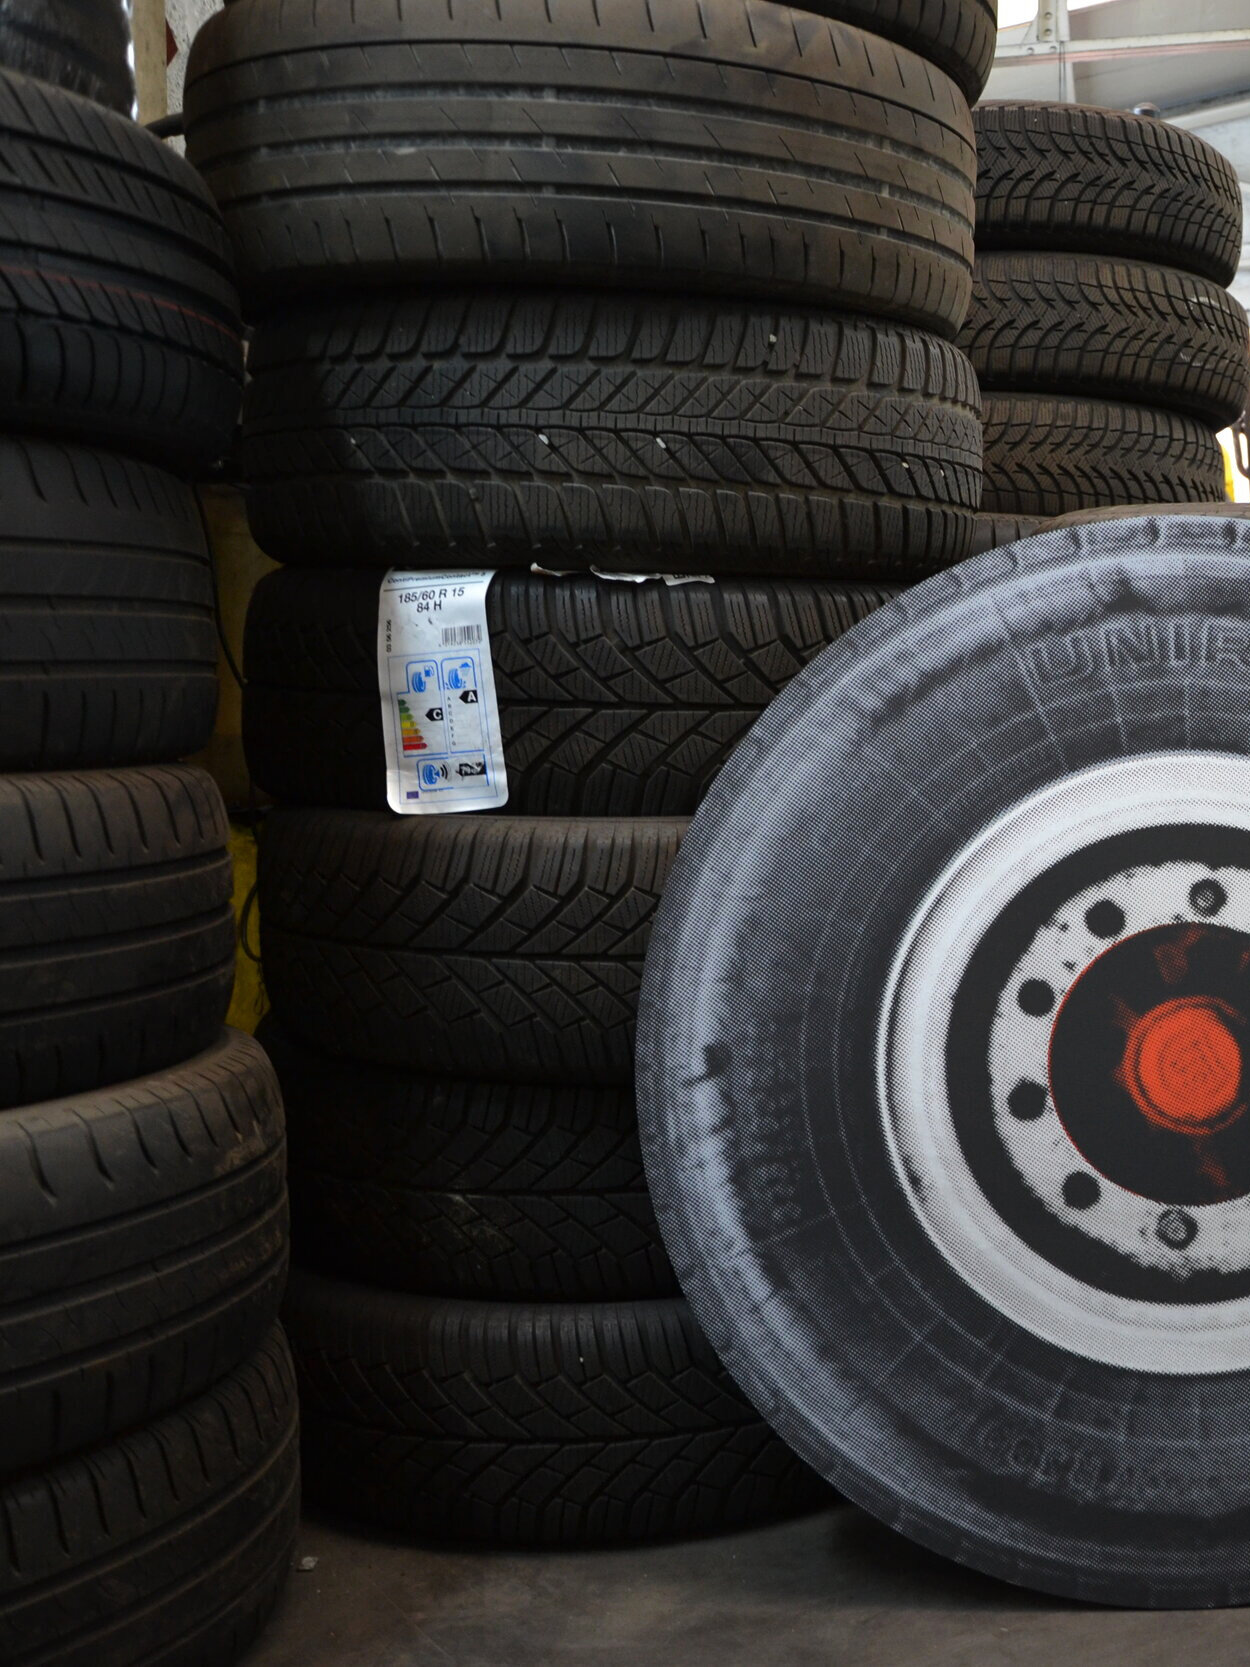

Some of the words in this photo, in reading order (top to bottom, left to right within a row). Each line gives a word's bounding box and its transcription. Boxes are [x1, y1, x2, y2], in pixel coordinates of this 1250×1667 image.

[398, 589, 435, 604] 185/60
[439, 588, 448, 599] R
[453, 586, 465, 597] 15
[416, 601, 430, 613] 84
[433, 600, 442, 611] H
